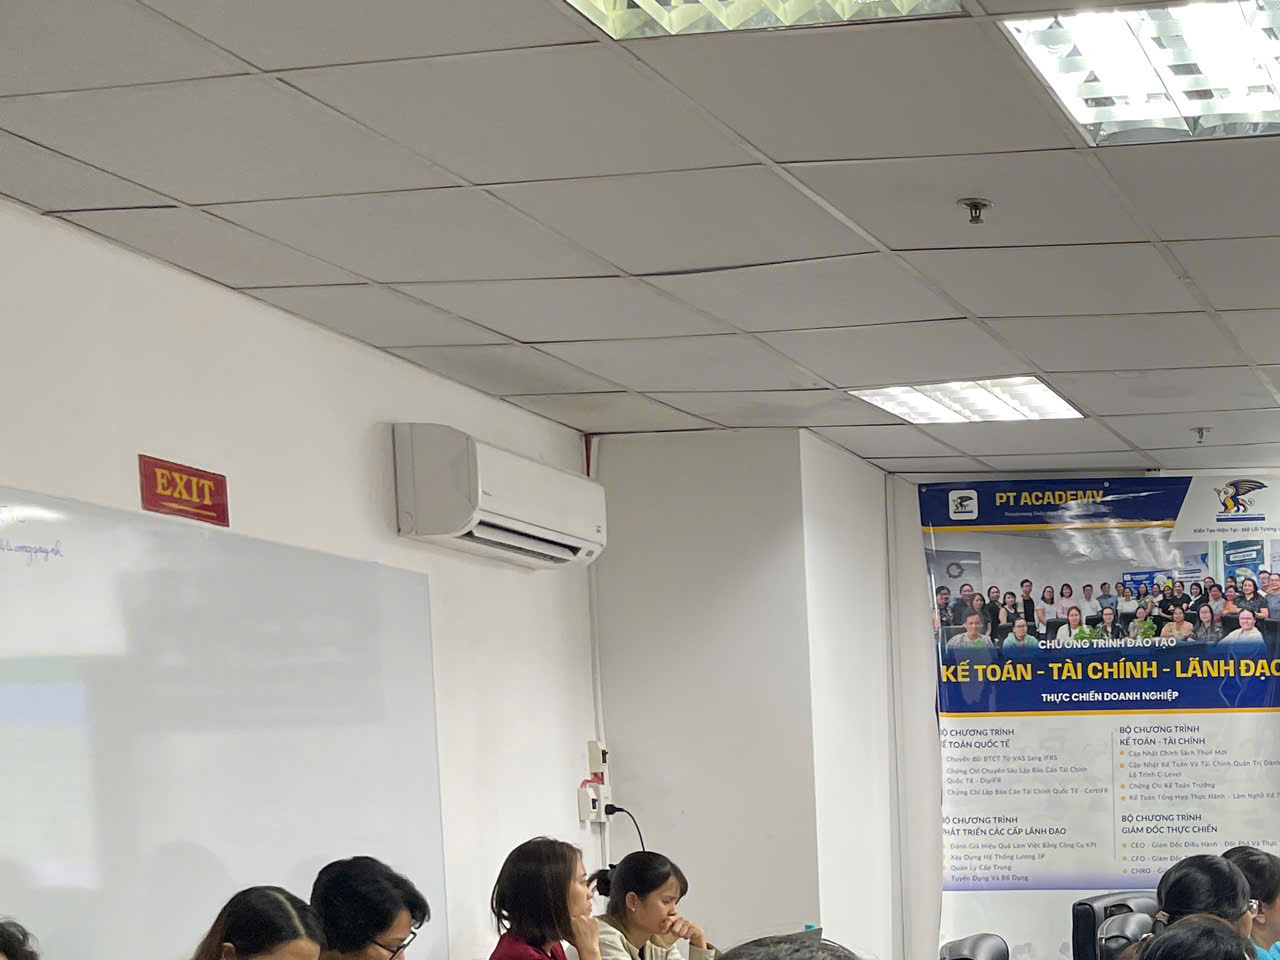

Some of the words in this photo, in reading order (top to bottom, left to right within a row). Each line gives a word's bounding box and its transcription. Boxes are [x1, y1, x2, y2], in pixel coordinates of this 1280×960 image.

[155, 468, 215, 505] EXIT
[995, 492, 1016, 506] PT
[1020, 490, 1103, 505] ACADEMY
[1155, 637, 1176, 648] TẠO
[942, 659, 970, 682] KẾ
[974, 660, 1032, 681] TOÁN
[1049, 659, 1082, 680] TÀI
[1088, 658, 1157, 679] CHÍNH
[1176, 657, 1235, 678] LÃNH
[1041, 693, 1070, 703] THỰC
[1072, 690, 1102, 702] CHIẾN
[1104, 691, 1140, 701] DOANH
[1142, 689, 1179, 701] NGHIỆP
[950, 728, 988, 736] CHƯƠNG
[990, 727, 1014, 736] TRÌNH
[1120, 726, 1131, 735] BỘ
[1134, 725, 1172, 733] CHƯƠNG
[1174, 724, 1199, 733] TRÌNH
[949, 740, 972, 748] TOÁN
[974, 739, 998, 749] QUỐC
[1120, 737, 1130, 746] KẾ
[1133, 737, 1155, 745] TOÁN
[1163, 737, 1176, 745] TÀI
[1178, 737, 1205, 745] CHÍNH
[952, 816, 991, 824] CHƯƠNG
[993, 816, 1018, 824] TRÌNH
[1122, 815, 1133, 823] BỘ
[1136, 814, 1174, 822] CHƯƠNG
[1176, 814, 1201, 822] TRÌNH
[988, 827, 1005, 836] CÁC
[1122, 825, 1144, 834] GIÁM
[1146, 824, 1165, 834] ĐỐC
[1167, 826, 1190, 835] THỰC
[1192, 824, 1218, 833] CHIẾN
